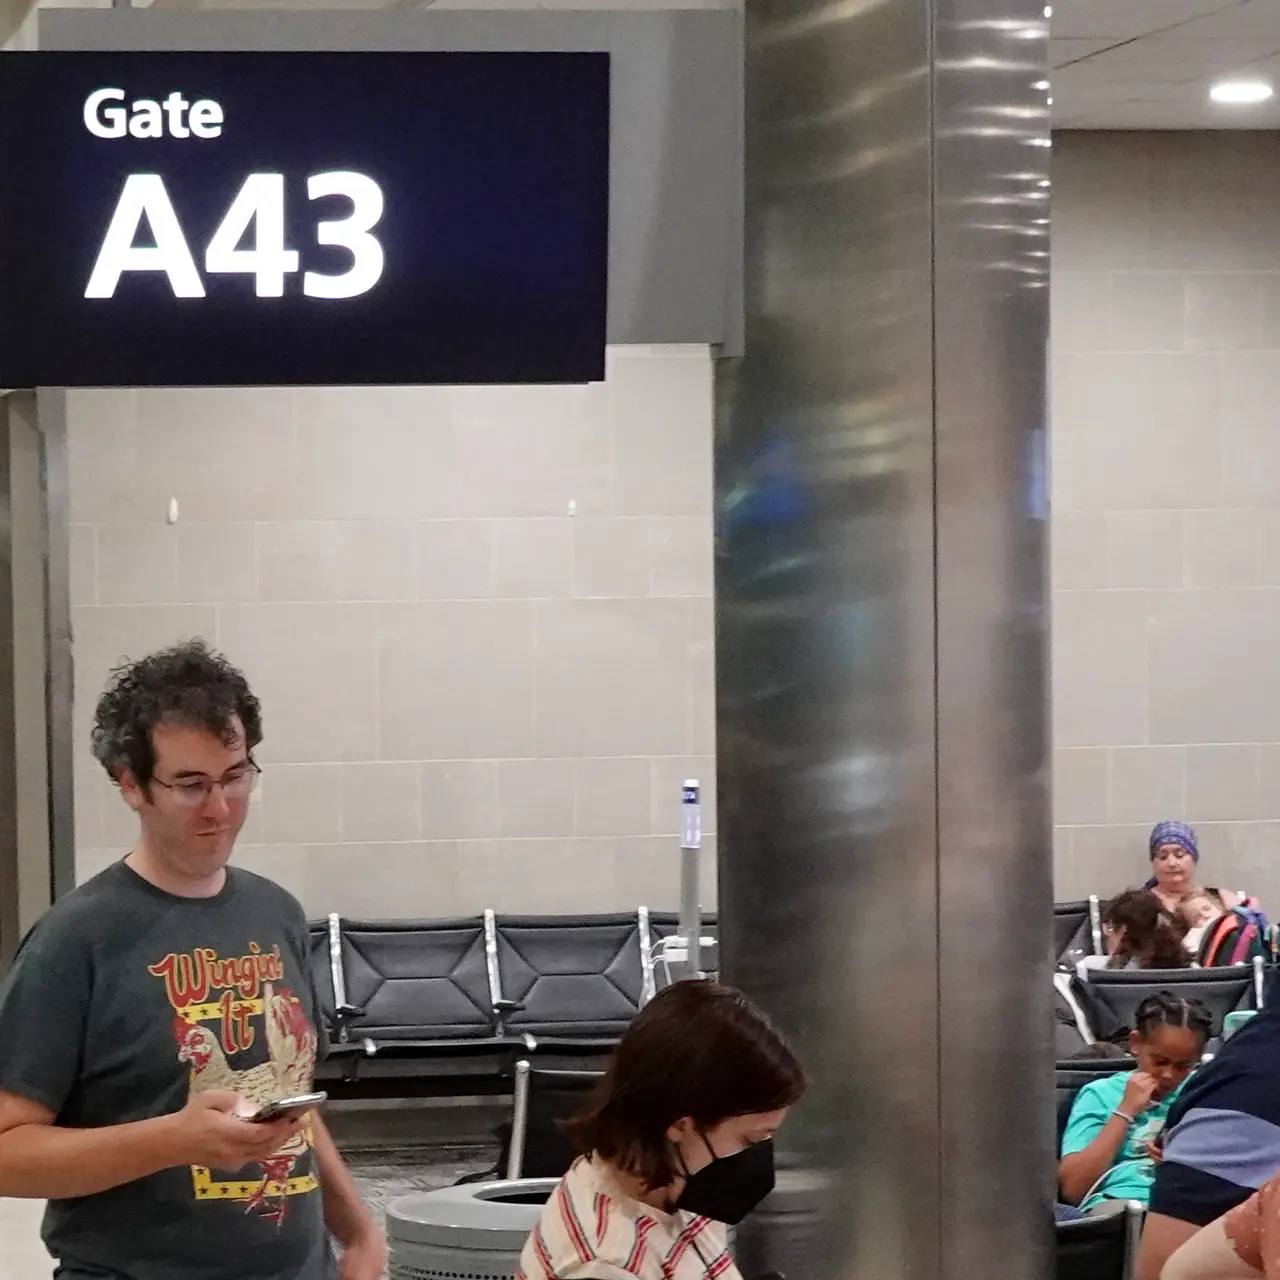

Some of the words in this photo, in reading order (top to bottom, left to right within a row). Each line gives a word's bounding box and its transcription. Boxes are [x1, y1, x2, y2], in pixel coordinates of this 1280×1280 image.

[83, 88, 224, 138] Gate
[83, 171, 384, 299] A43
[221, 990, 255, 1054] It
